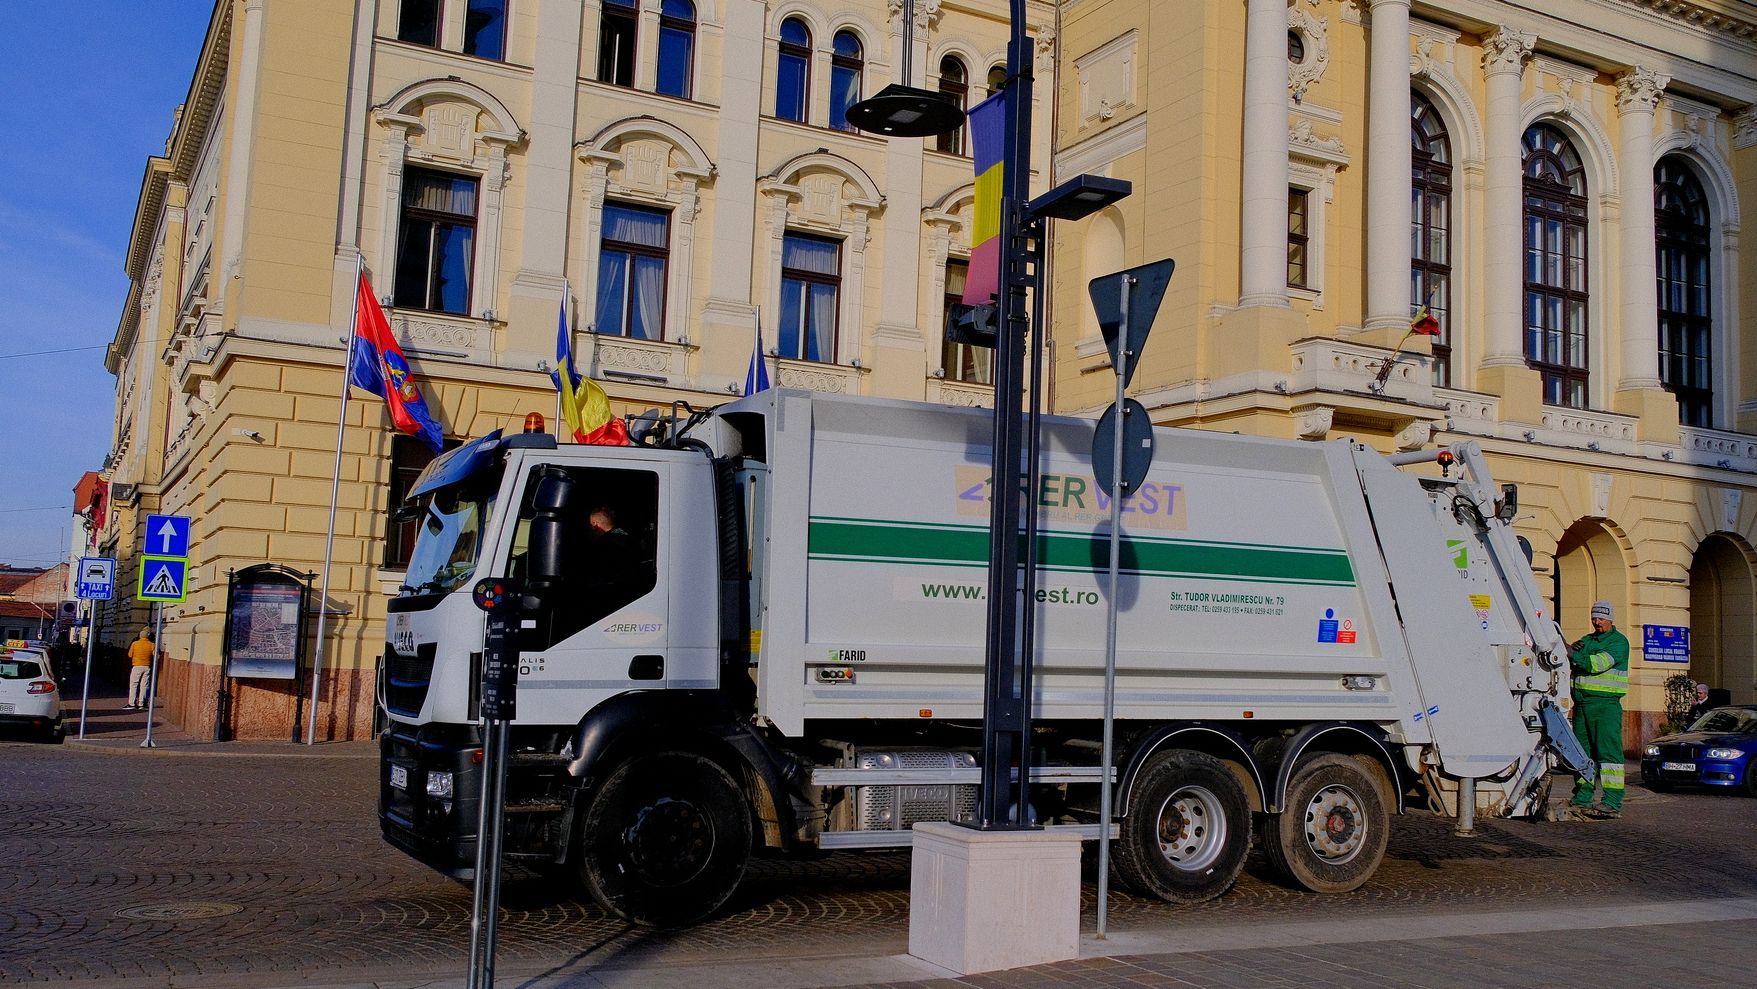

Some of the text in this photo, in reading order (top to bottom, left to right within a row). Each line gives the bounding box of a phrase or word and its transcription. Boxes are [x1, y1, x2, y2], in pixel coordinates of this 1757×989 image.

[89, 583, 103, 591] TAXI
[922, 583, 1099, 605] www.est.ro
[1170, 591, 1285, 605] Str. TUDOR VLADIMIRESCU Nr. 79
[616, 623, 663, 633] RER VEST
[839, 650, 866, 661] FARID
